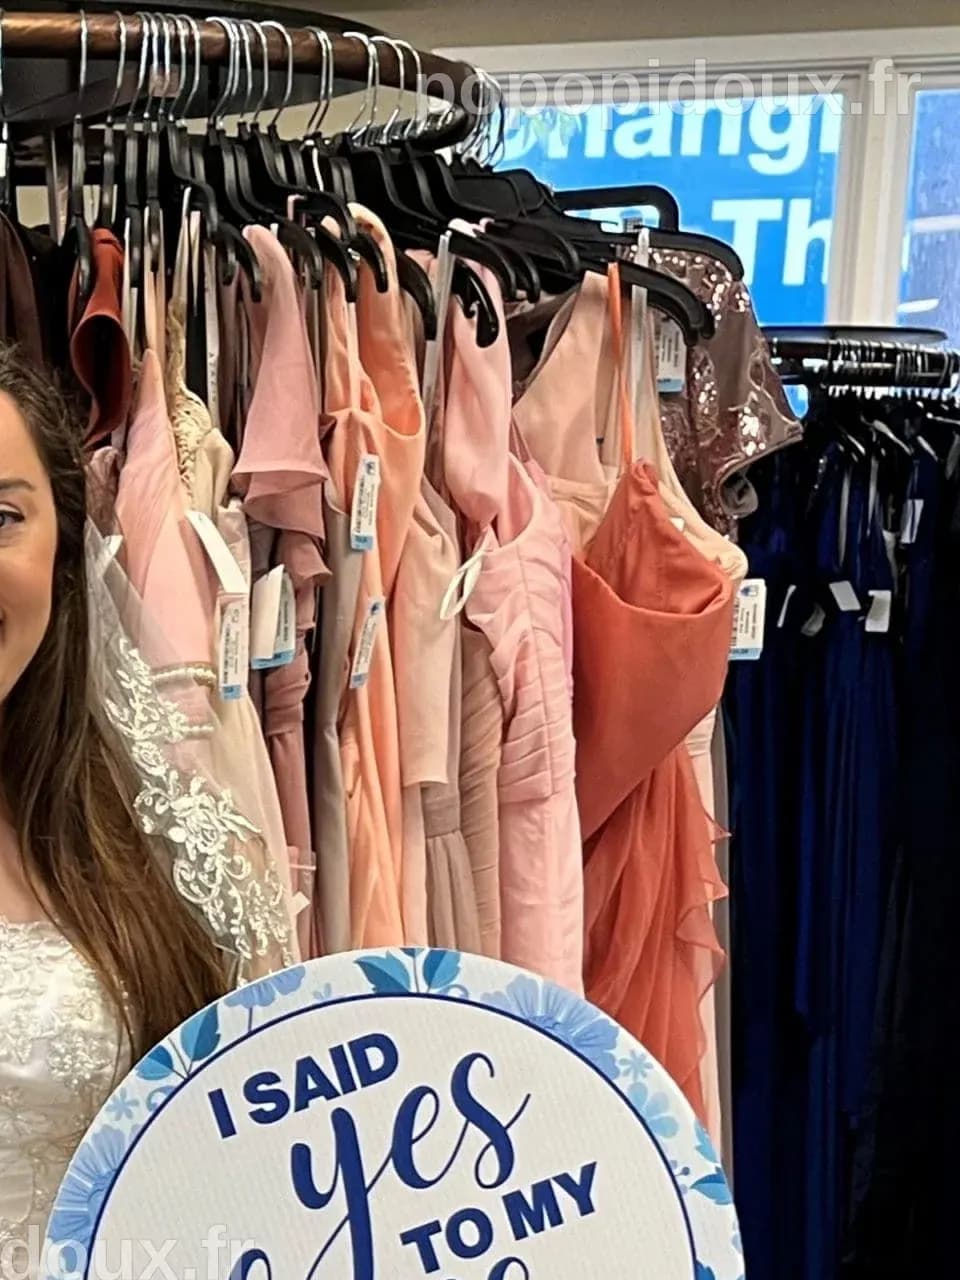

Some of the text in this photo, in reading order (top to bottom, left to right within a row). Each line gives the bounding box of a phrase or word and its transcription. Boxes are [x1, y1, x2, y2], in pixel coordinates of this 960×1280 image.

[208, 1033, 399, 1138] I SAID
[400, 1161, 597, 1274] TO MY
